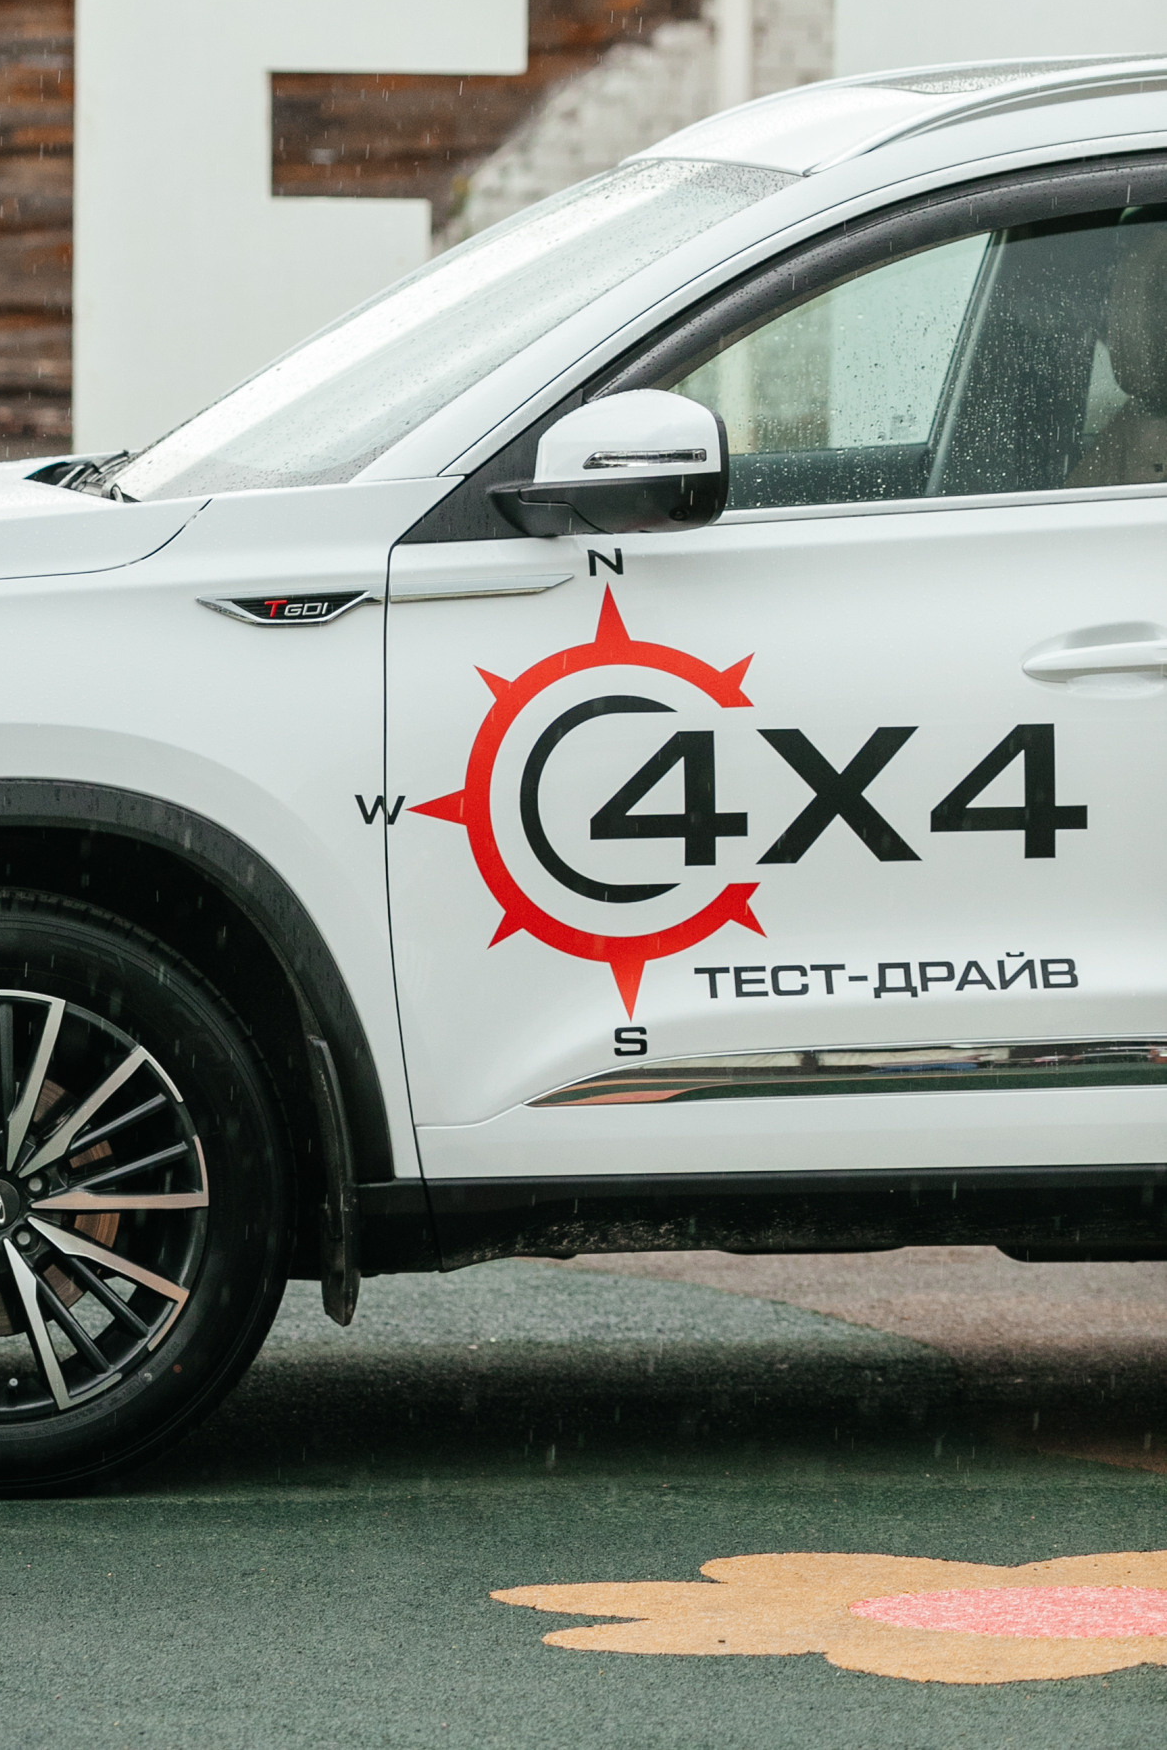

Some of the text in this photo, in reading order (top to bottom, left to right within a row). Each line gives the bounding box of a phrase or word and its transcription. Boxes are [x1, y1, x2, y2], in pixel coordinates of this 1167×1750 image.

[587, 548, 623, 576] N
[354, 794, 406, 825] W
[589, 723, 1088, 866] 4X4
[694, 951, 1079, 1000] ТЕСТ-ДРАЙВ
[613, 1026, 648, 1056] S
